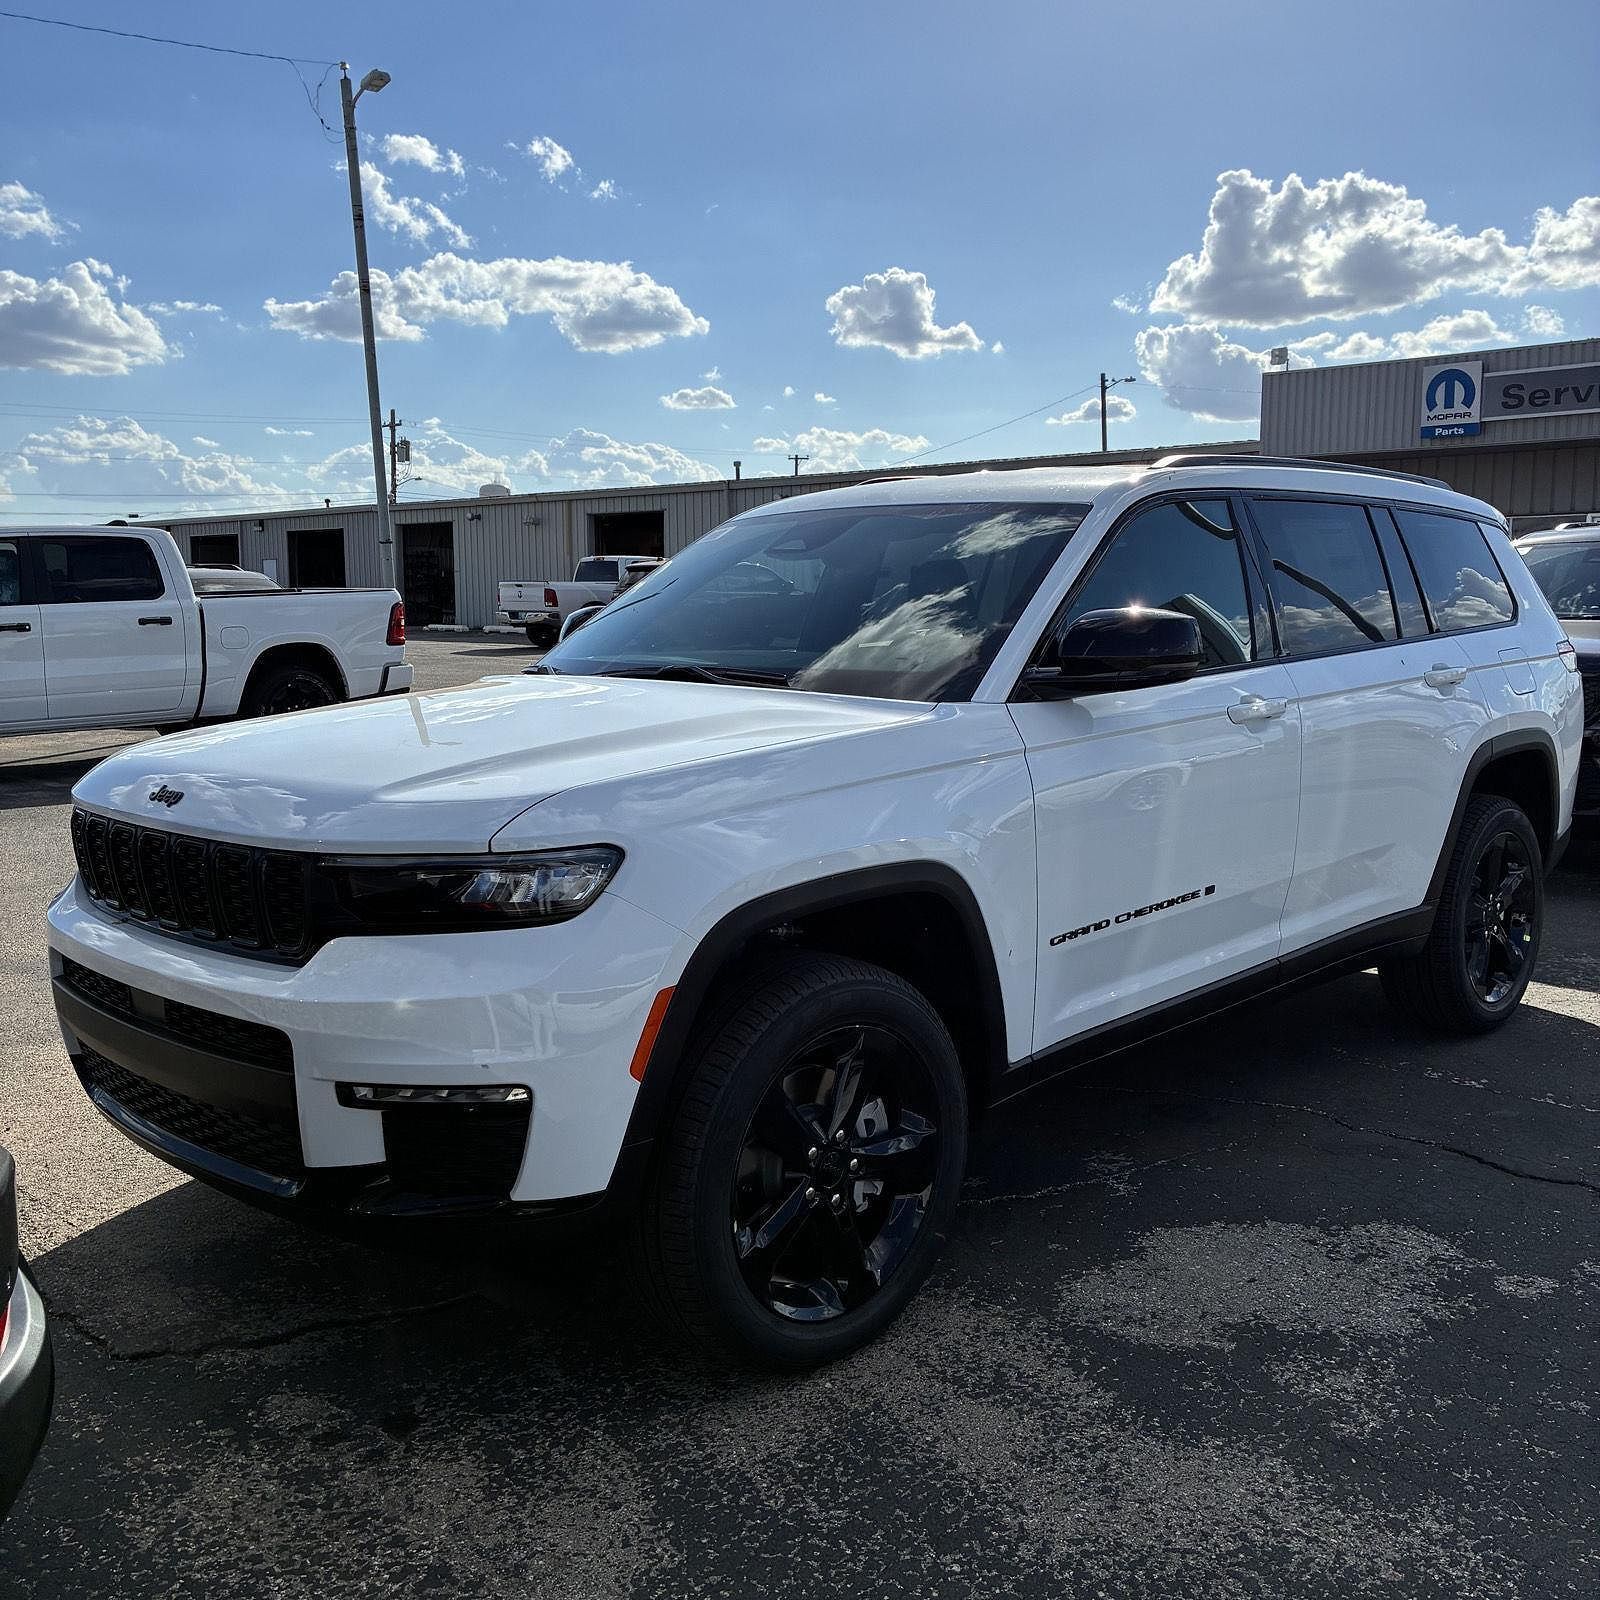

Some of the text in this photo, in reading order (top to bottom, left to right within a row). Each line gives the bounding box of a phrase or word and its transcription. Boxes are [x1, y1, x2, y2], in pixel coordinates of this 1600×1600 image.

[1501, 383, 1600, 410] Serv
[1426, 411, 1472, 422] MOPAR
[1434, 426, 1465, 437] Parts
[149, 784, 185, 808] Jeep
[1049, 889, 1202, 947] GRAND CHEROKEE
